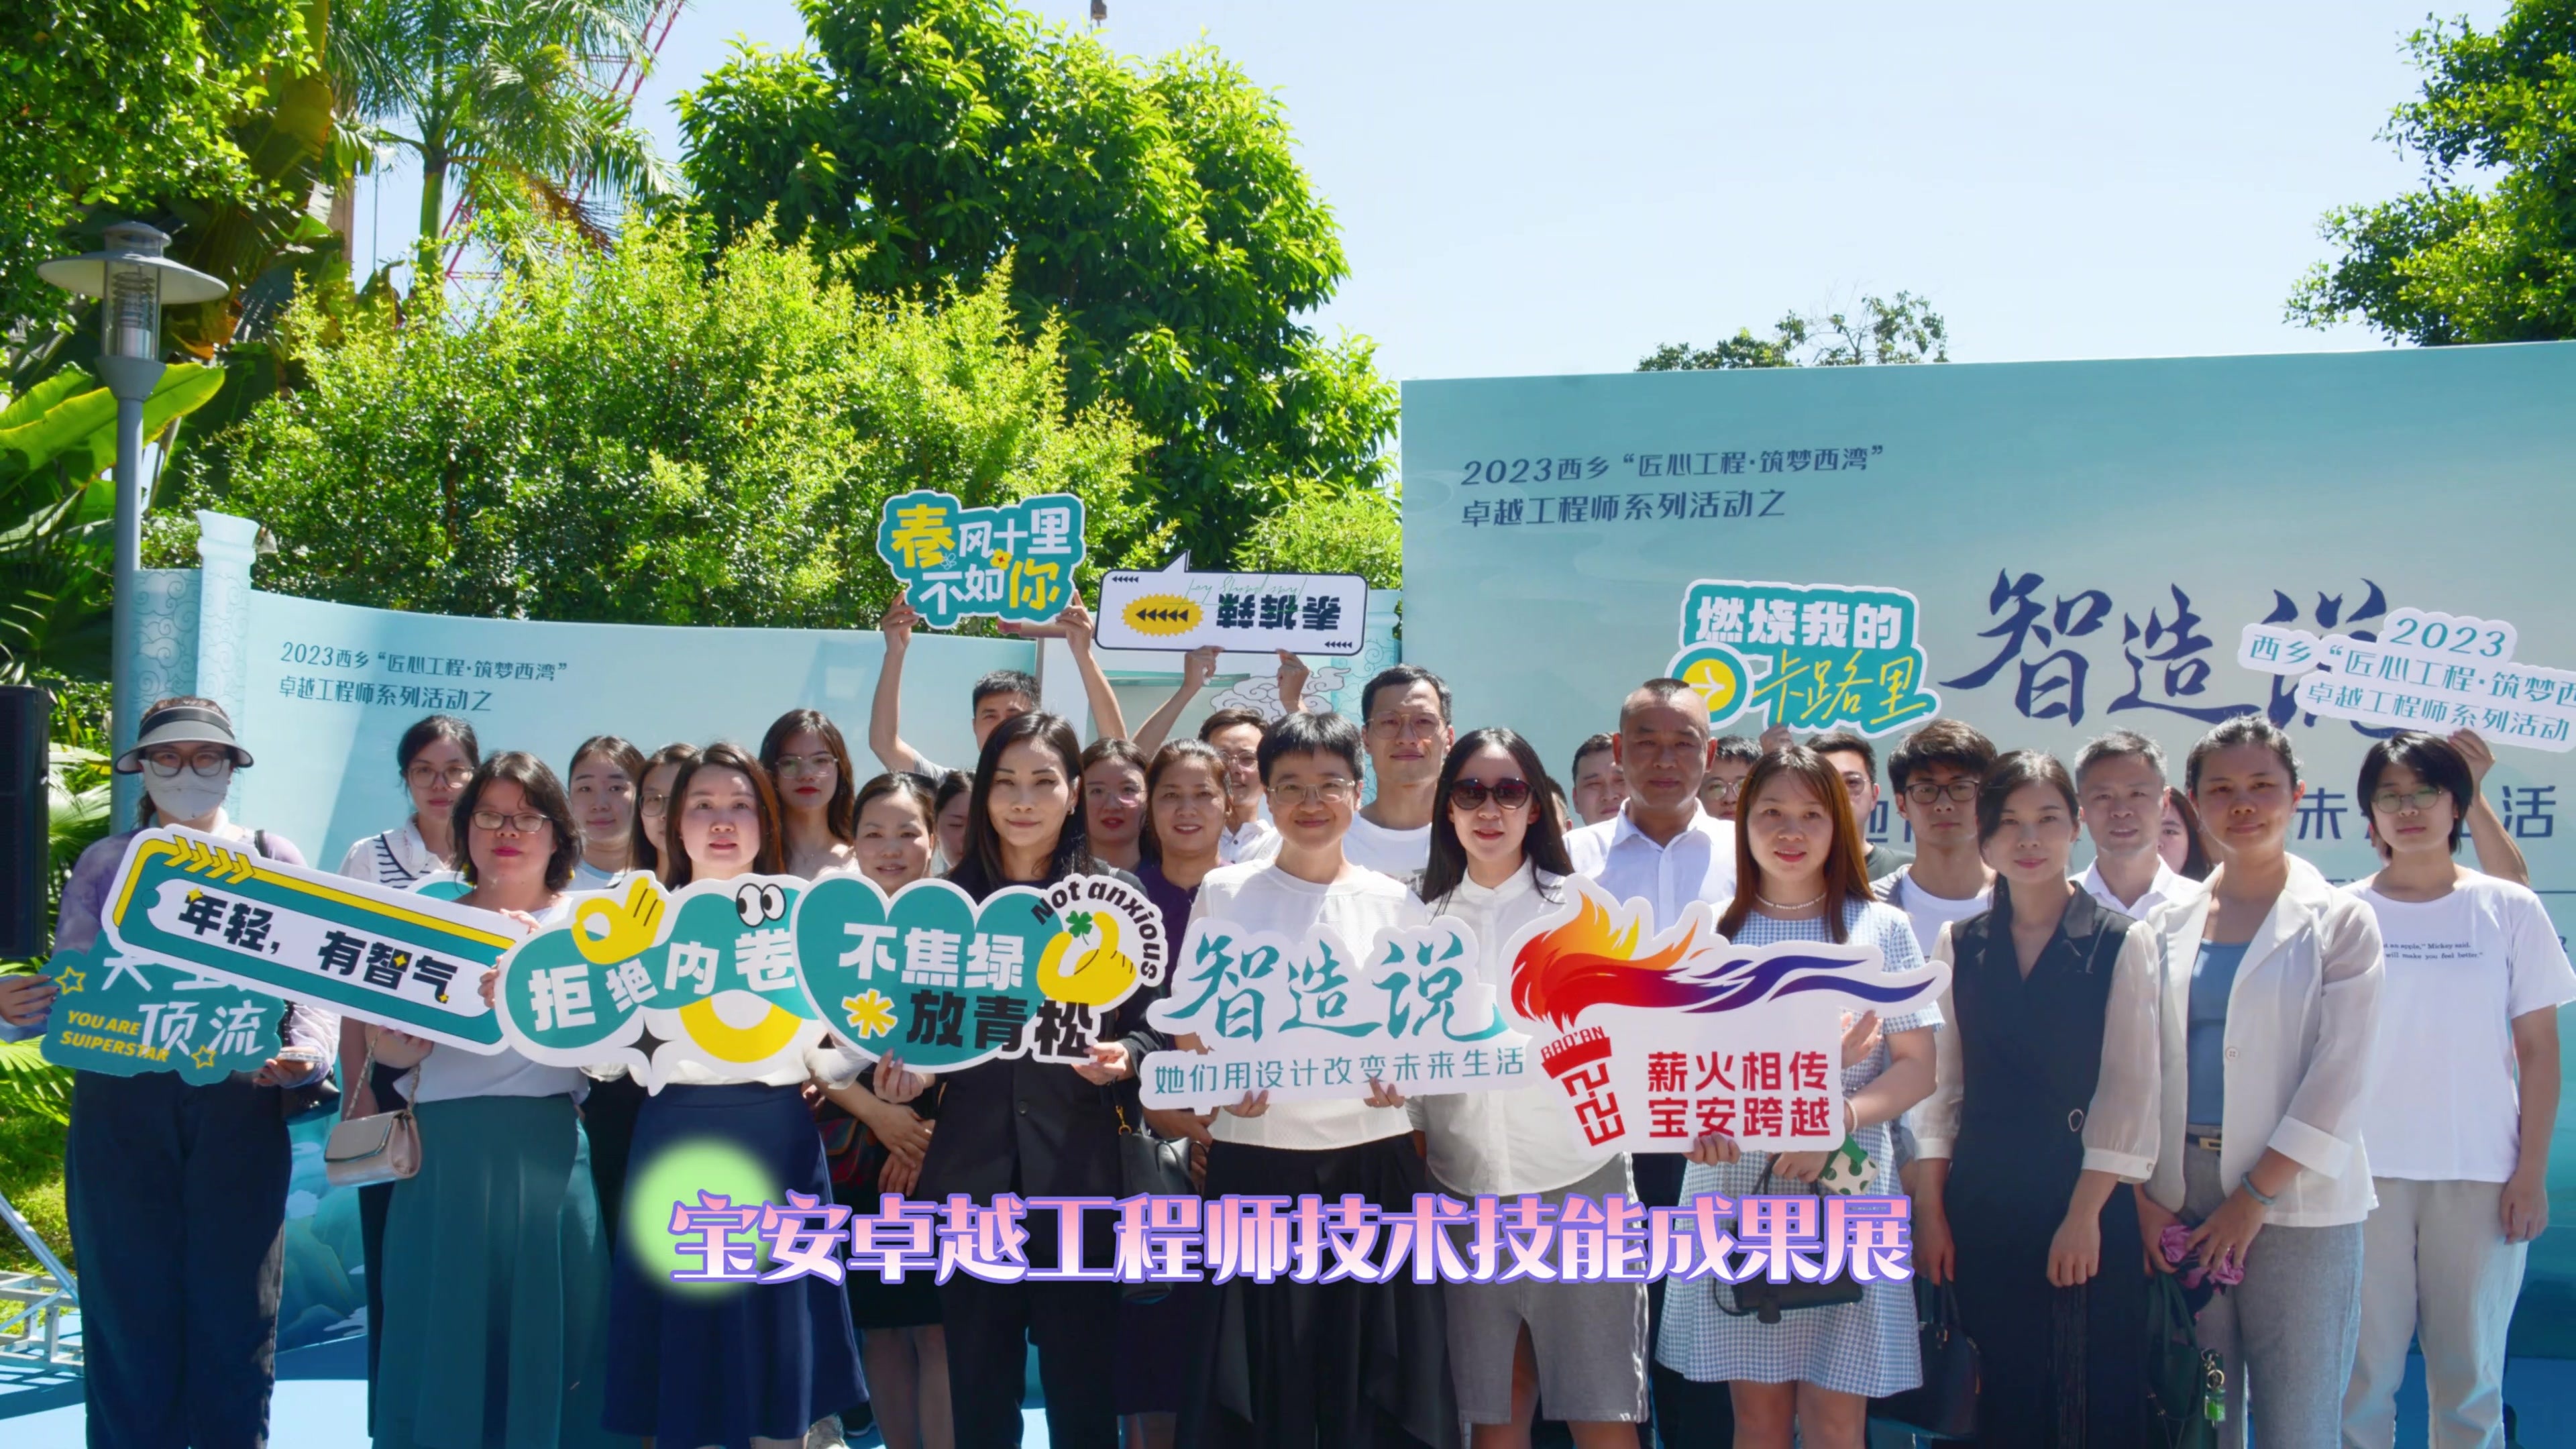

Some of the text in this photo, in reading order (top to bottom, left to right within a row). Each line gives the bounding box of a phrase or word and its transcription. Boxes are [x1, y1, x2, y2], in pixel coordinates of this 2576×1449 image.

[1461, 489, 1786, 527] 卓越工程师系列活动之
[918, 558, 1060, 615] 不如你
[1695, 596, 1902, 649] 燃烧我的
[2390, 618, 2506, 657] 2023
[279, 676, 493, 712] 卓越工程师系列活动之
[1752, 649, 1927, 725] 卡路里
[2306, 682, 2570, 741] 卓越工程师系列活动
[839, 922, 1024, 991] 不焦绿
[1031, 881, 1161, 980] Not anxious
[528, 928, 796, 1032] 拒绝内卷
[1162, 930, 1509, 1042] 智造说
[60, 1030, 170, 1063] SUIPERSTAR
[67, 1010, 142, 1036] YOU ARE
[138, 999, 268, 1057] 顶流
[906, 989, 1093, 1059] 放青松
[1540, 1026, 1606, 1063] BAO'AN
[1155, 1046, 1525, 1095] 她们用设计改变未来生活
[1648, 1051, 1829, 1092] 薪火相传
[1648, 1097, 1831, 1138] 宝安跨越
